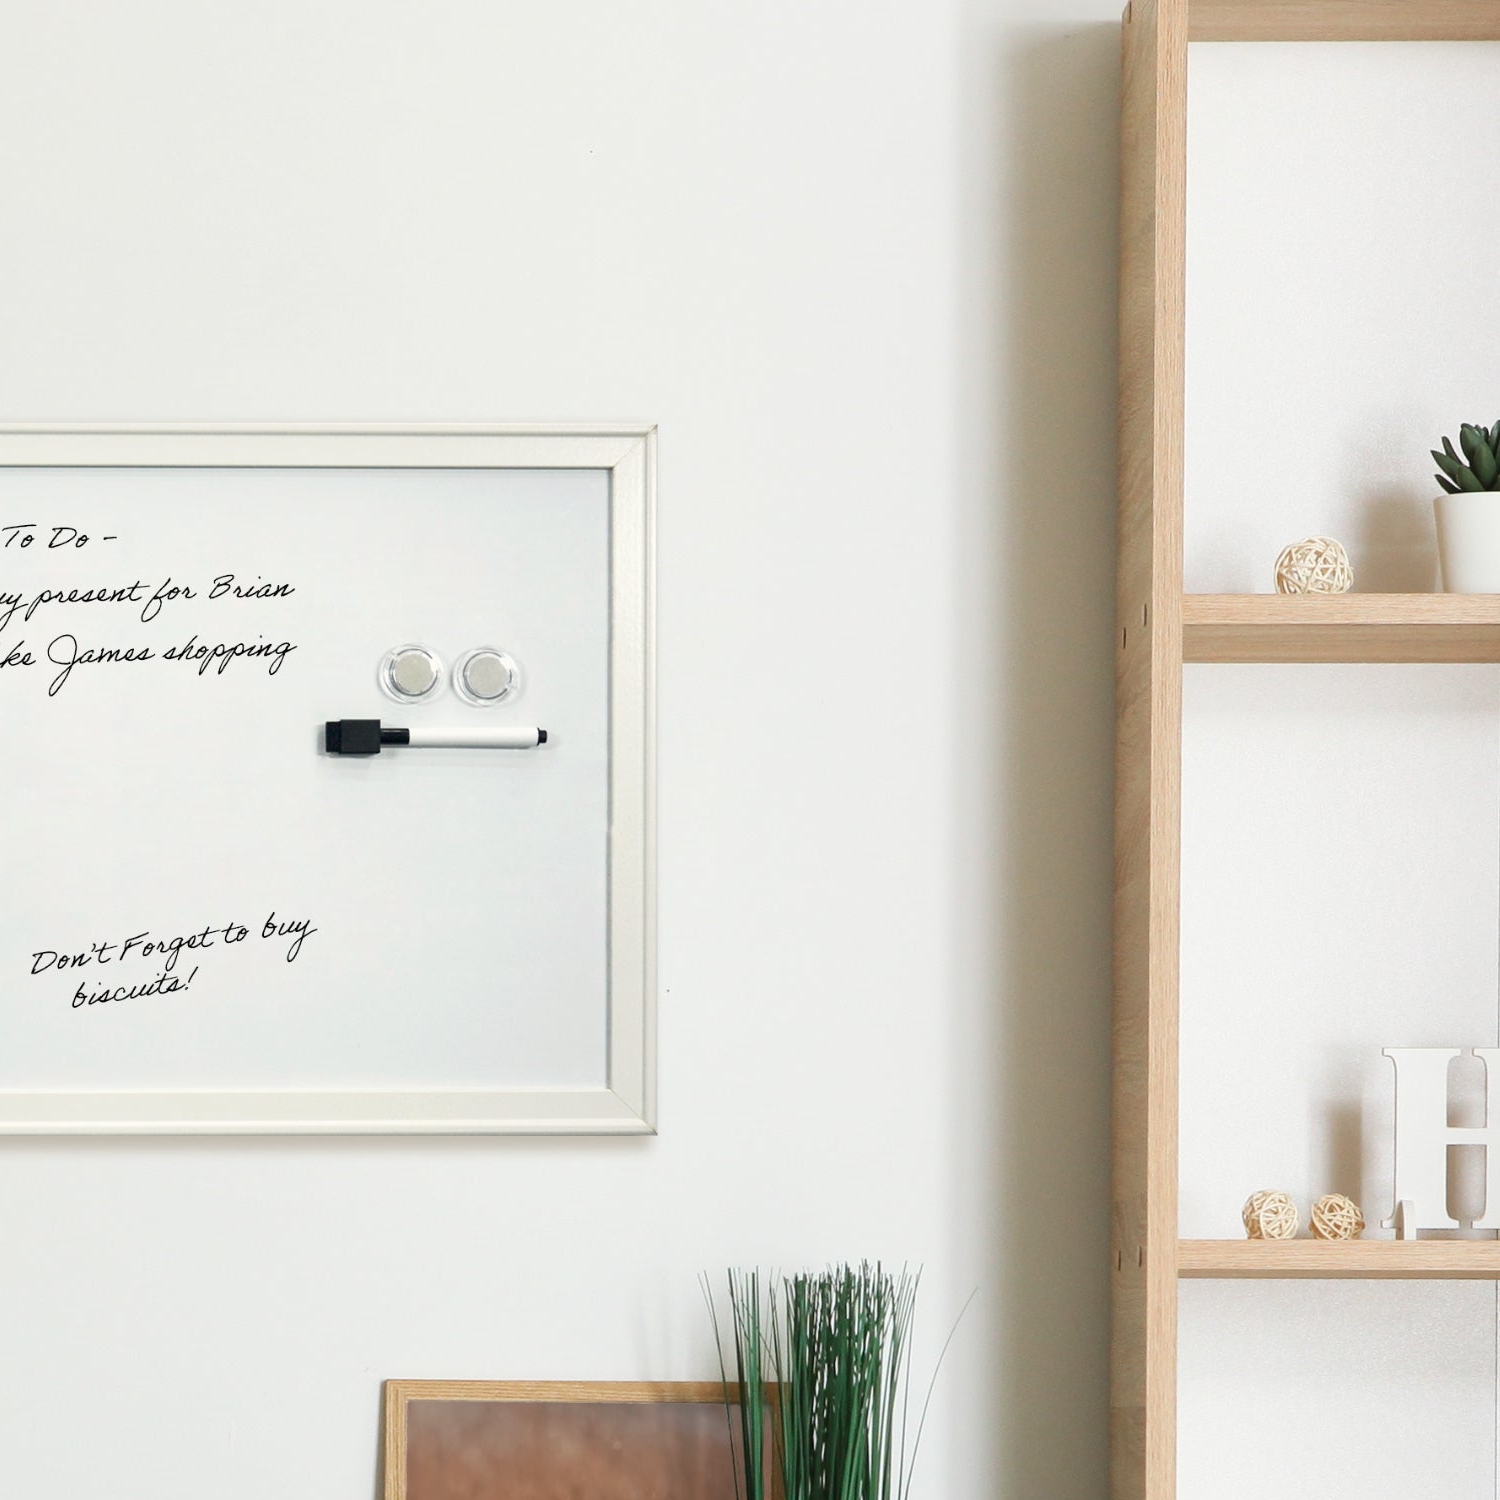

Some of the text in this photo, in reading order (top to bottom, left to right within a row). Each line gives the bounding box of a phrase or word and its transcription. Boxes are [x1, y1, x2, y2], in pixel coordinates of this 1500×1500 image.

[1, 523, 36, 548] To
[48, 526, 90, 549] Do
[24, 580, 151, 622] present
[141, 577, 198, 623] for
[208, 574, 296, 600] Brian
[47, 633, 156, 697] James
[161, 634, 298, 676] shopping
[30, 911, 318, 975] Don't Forget to buy
[71, 965, 199, 1009] biscuits!
